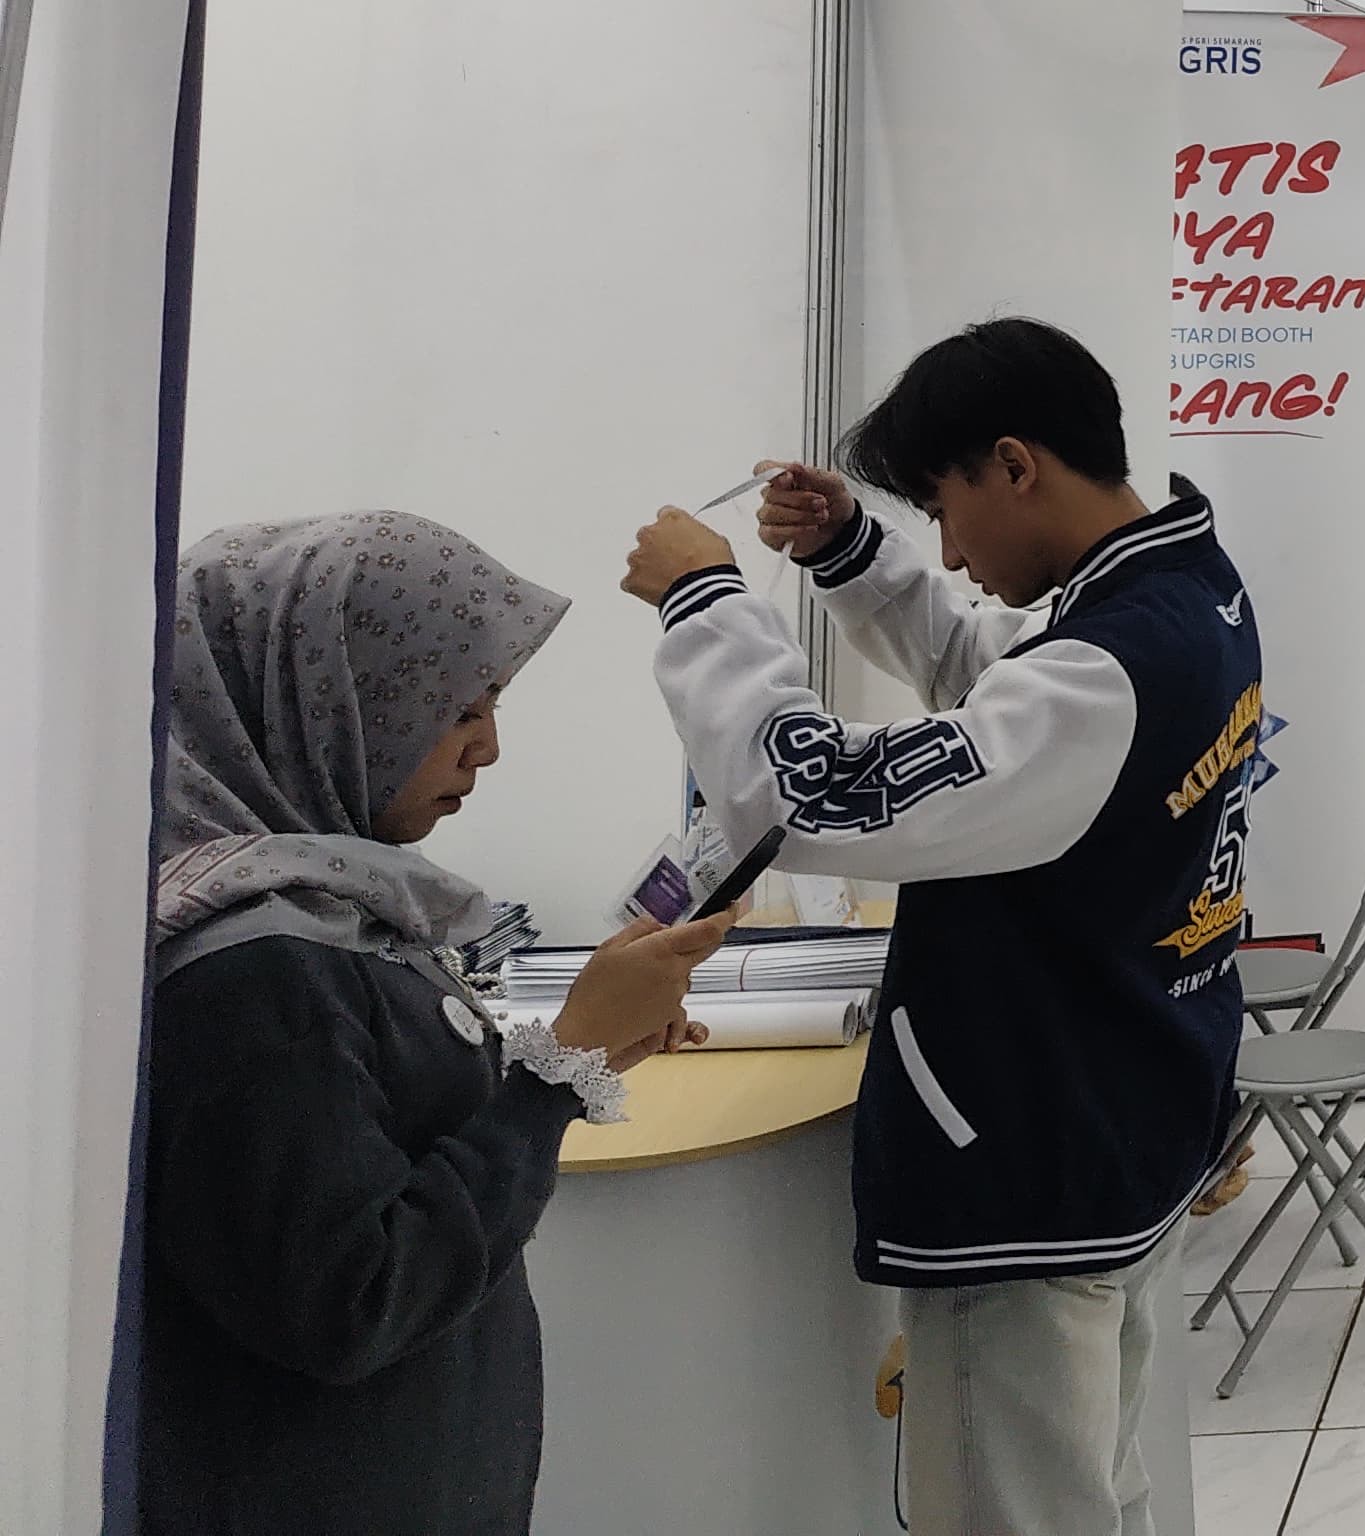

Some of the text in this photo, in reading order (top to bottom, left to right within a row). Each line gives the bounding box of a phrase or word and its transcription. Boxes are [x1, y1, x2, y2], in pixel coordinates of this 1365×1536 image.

[1213, 38, 1262, 46] SEMARANG
[1218, 327, 1237, 344] DI
[1241, 327, 1313, 344] BOOTH
[1182, 353, 1256, 370] UPGRIS
